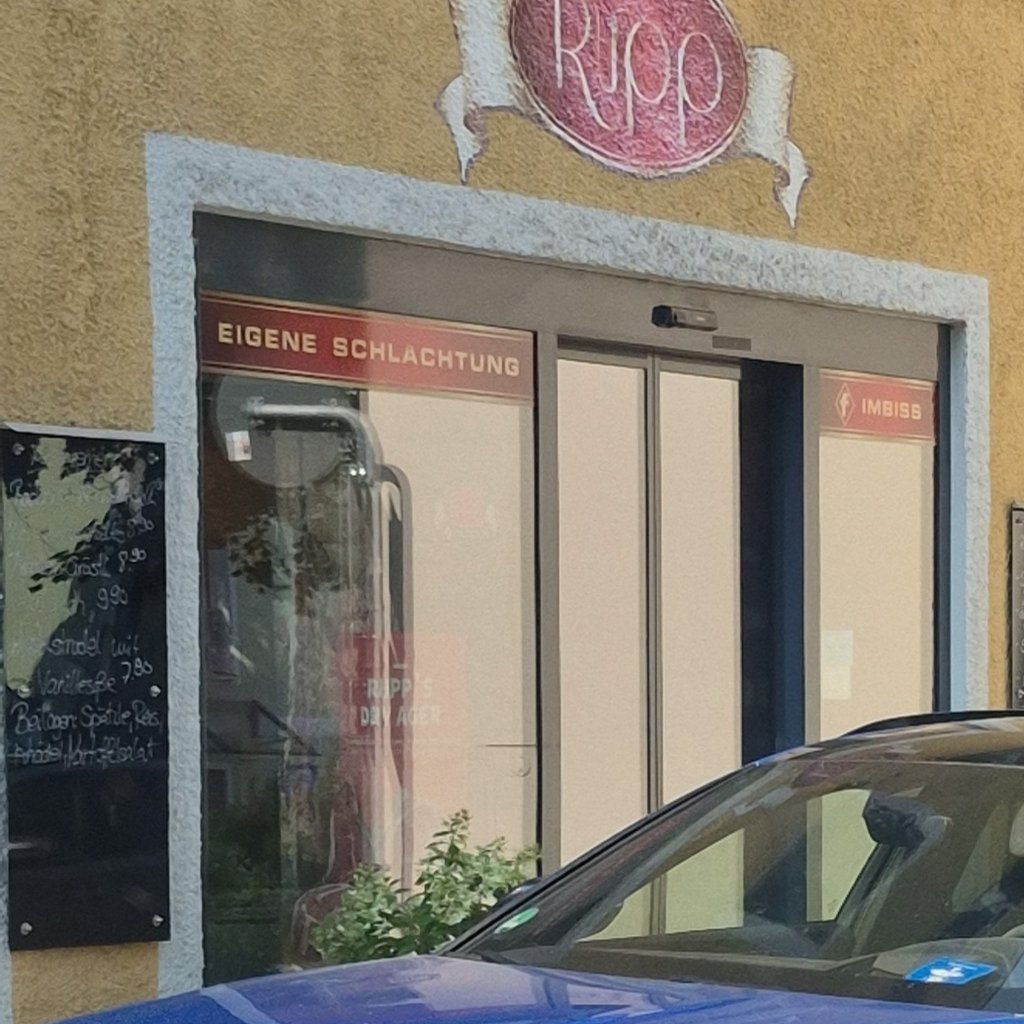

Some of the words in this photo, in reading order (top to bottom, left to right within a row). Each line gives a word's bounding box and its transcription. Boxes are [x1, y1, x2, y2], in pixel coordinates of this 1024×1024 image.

[217, 322, 318, 354] EIGENE
[332, 336, 521, 378] SCHLACHTUNG
[861, 397, 922, 421] IMBISS
